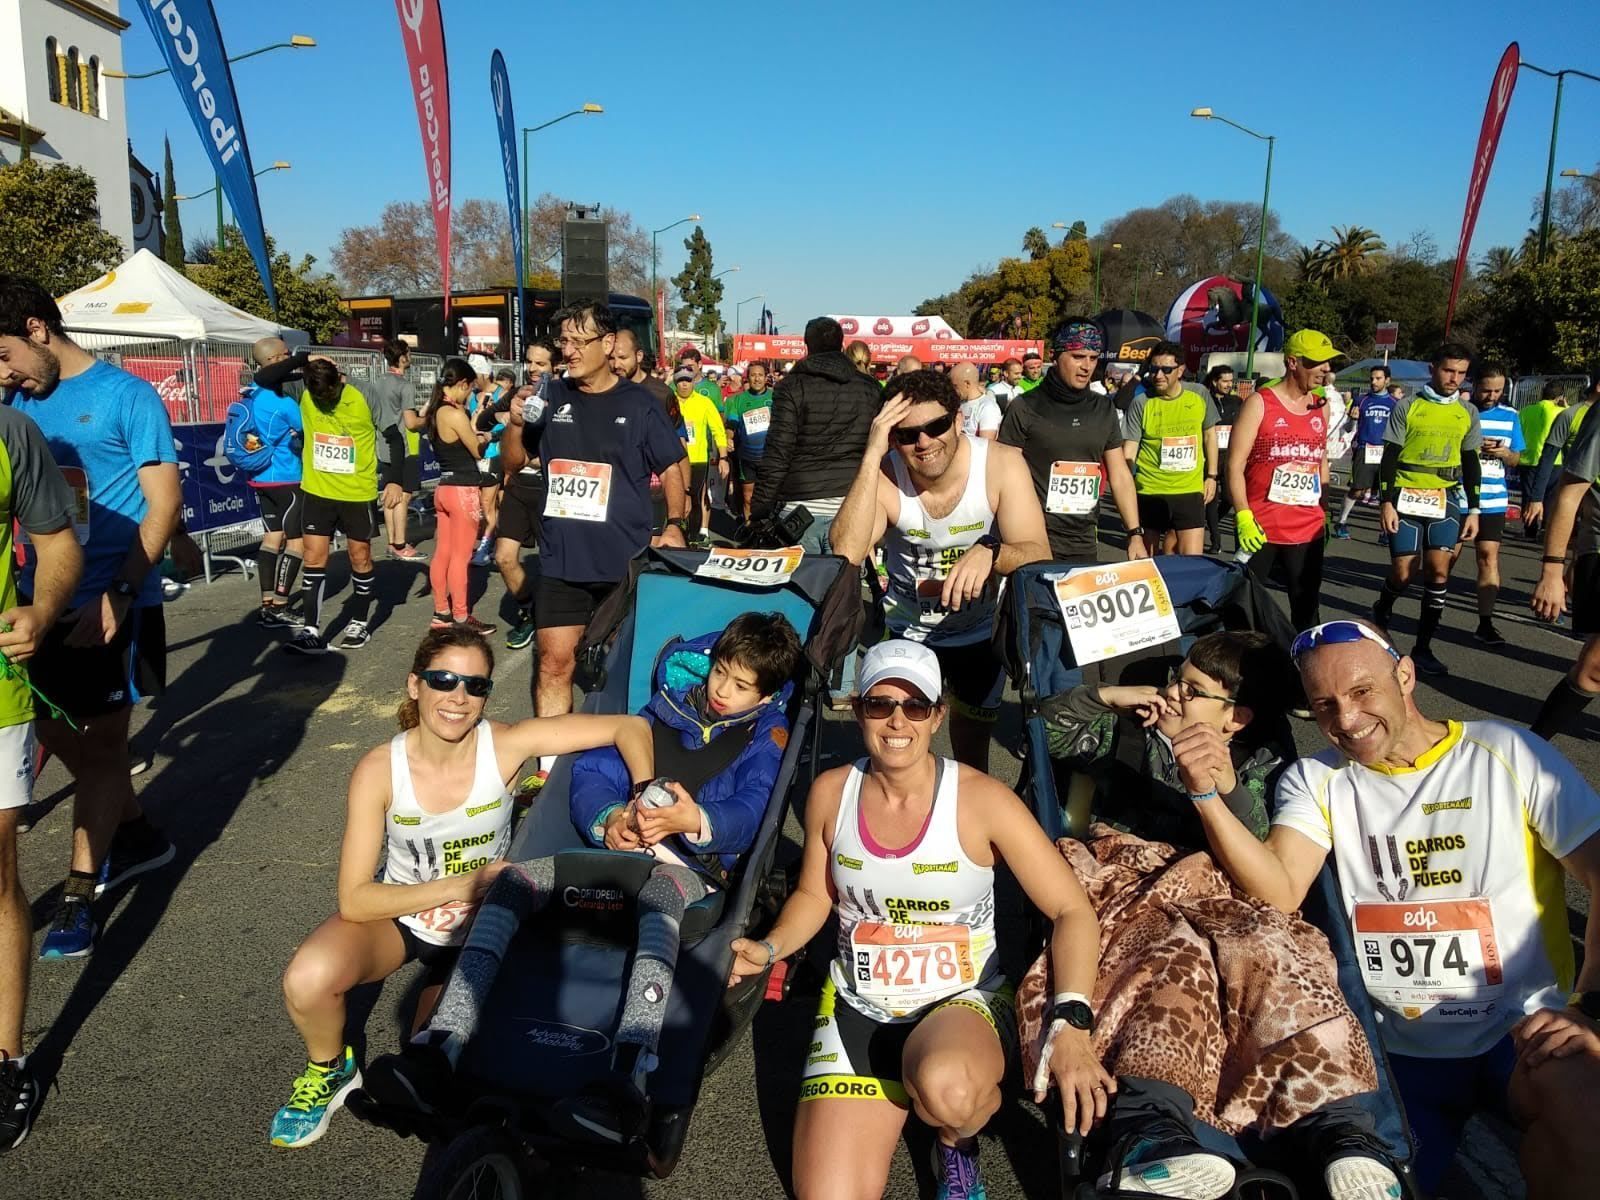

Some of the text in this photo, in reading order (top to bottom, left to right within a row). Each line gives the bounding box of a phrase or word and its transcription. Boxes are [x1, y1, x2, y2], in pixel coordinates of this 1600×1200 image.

[319, 445, 349, 461] 7528
[1168, 446, 1194, 460] 4877
[556, 477, 600, 500] 3497
[1059, 477, 1094, 496] 5513
[1281, 472, 1314, 490] 2395
[208, 495, 244, 514] iberCaja
[1095, 570, 1120, 585] edp
[1078, 583, 1155, 628] 9902
[442, 831, 496, 850] CARROS
[1406, 835, 1466, 854] CARROS
[444, 851, 461, 862] DE
[1410, 857, 1428, 871] DE
[444, 857, 487, 875] FUEGO
[1414, 870, 1463, 888] FUEGO
[885, 898, 950, 911] CARROS
[889, 910, 909, 920] DE
[1403, 907, 1438, 930] edp
[872, 946, 957, 986] 4278
[1390, 937, 1469, 978] 974
[1438, 1007, 1478, 1017] iberCaja
[526, 1028, 581, 1041] Advance
